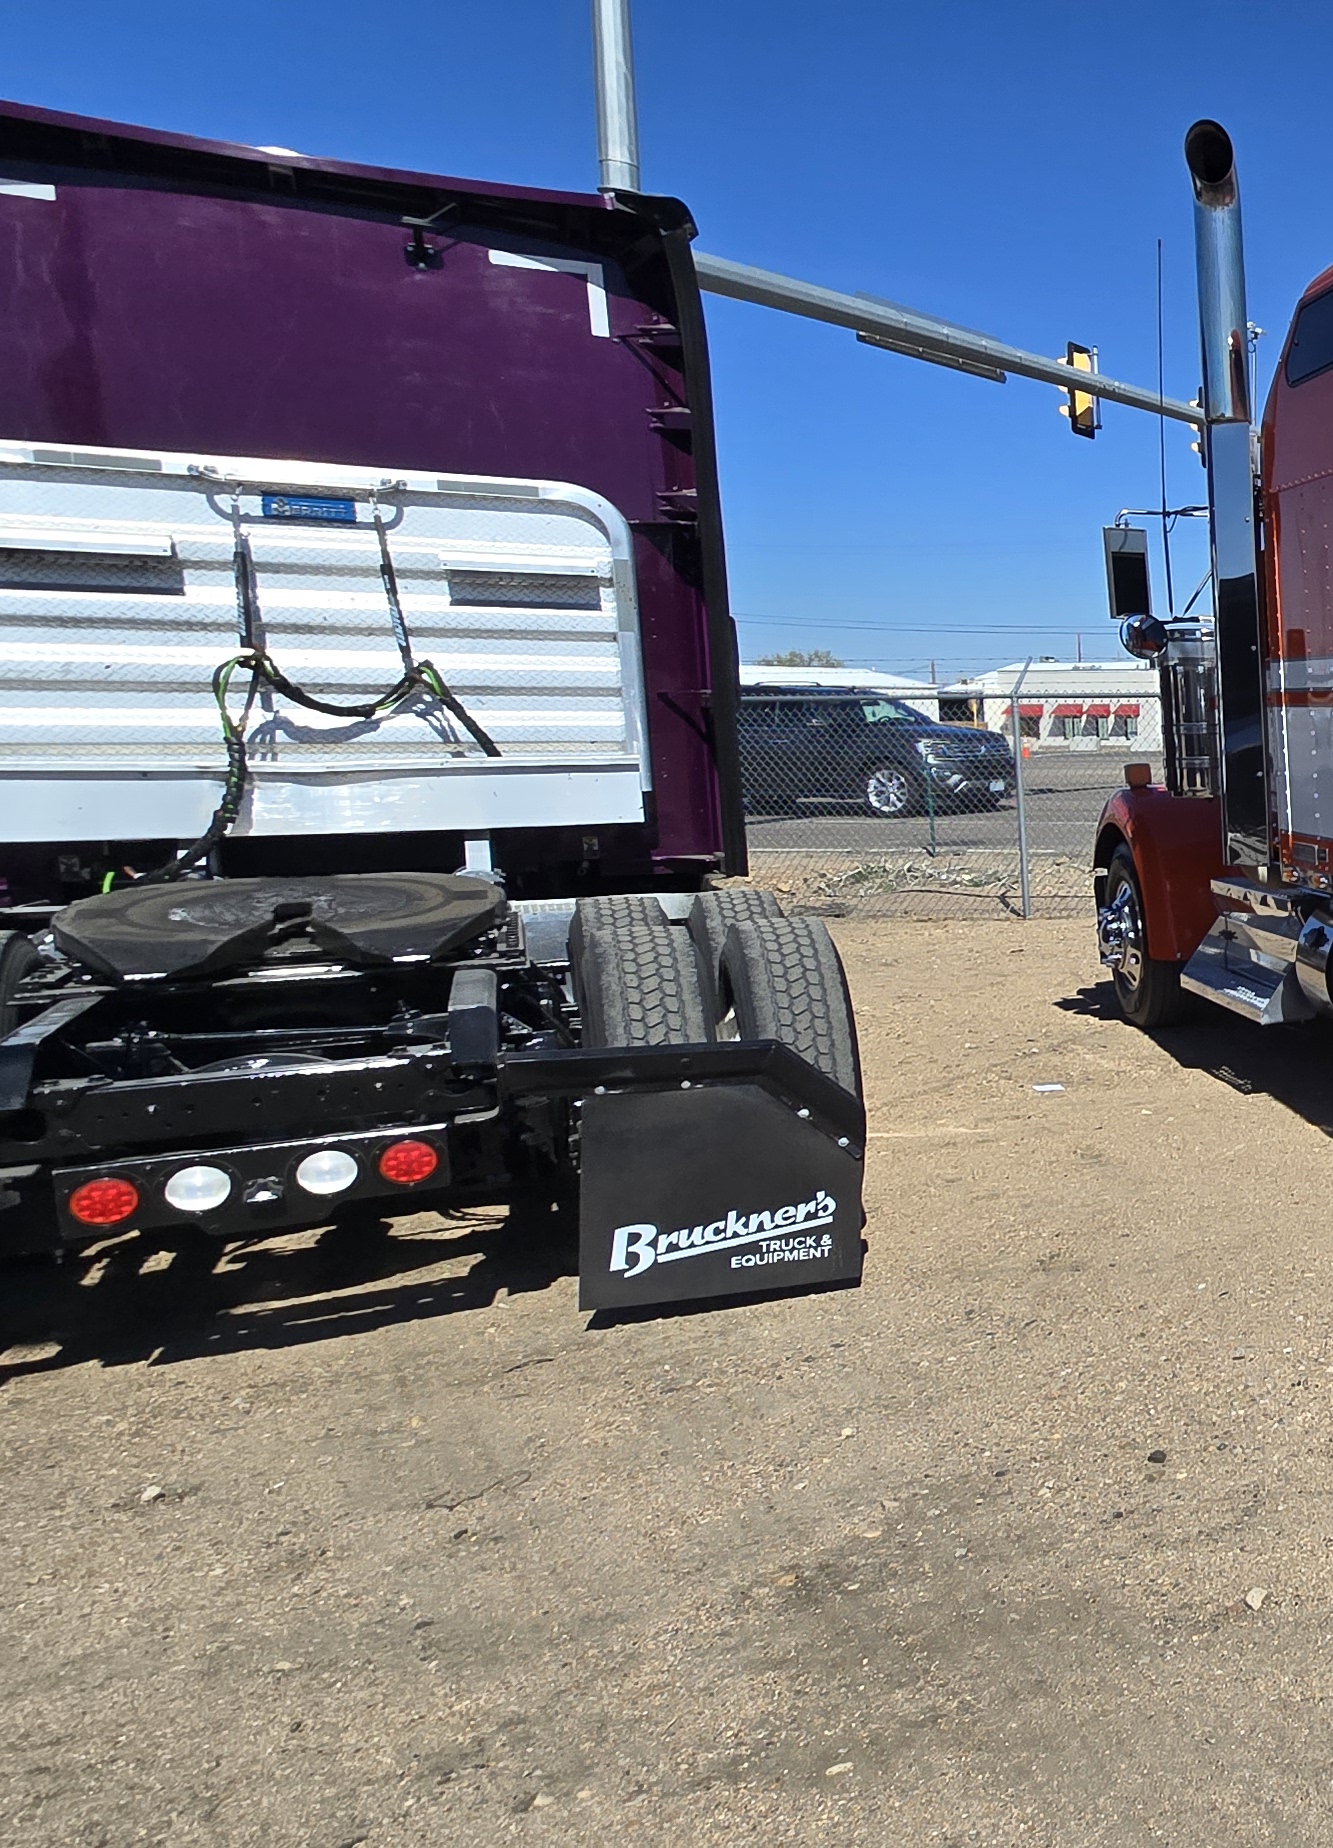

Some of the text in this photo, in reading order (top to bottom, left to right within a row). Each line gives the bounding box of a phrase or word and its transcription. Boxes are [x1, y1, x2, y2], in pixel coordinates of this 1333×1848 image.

[609, 1190, 836, 1278] Bruckner's
[759, 1234, 833, 1253] TRUCK &
[730, 1245, 832, 1269] EQUIPMENT
